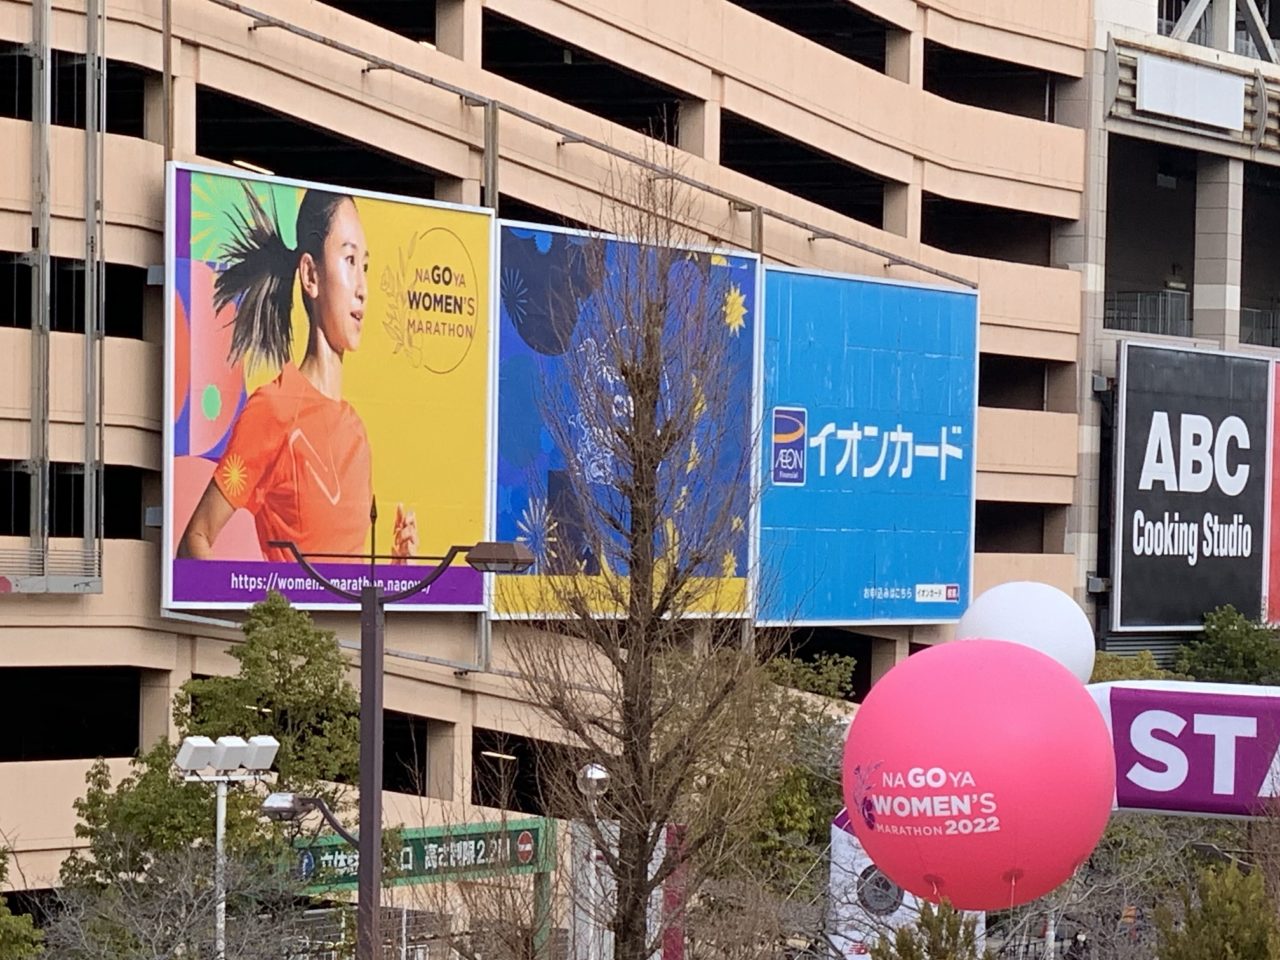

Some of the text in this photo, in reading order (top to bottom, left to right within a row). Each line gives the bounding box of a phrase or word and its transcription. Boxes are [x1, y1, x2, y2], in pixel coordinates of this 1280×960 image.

[415, 265, 467, 288] NAGOYA
[407, 290, 475, 317] WOMEN'S
[407, 319, 475, 339] MARATHON
[809, 421, 964, 481] イオンカード
[1138, 411, 1251, 496] ABC
[1132, 510, 1252, 566] Cooking Studio
[882, 767, 977, 789] NAGOYA
[871, 792, 998, 817] WOMEN'S
[876, 816, 1001, 836] MARATHON 2022
